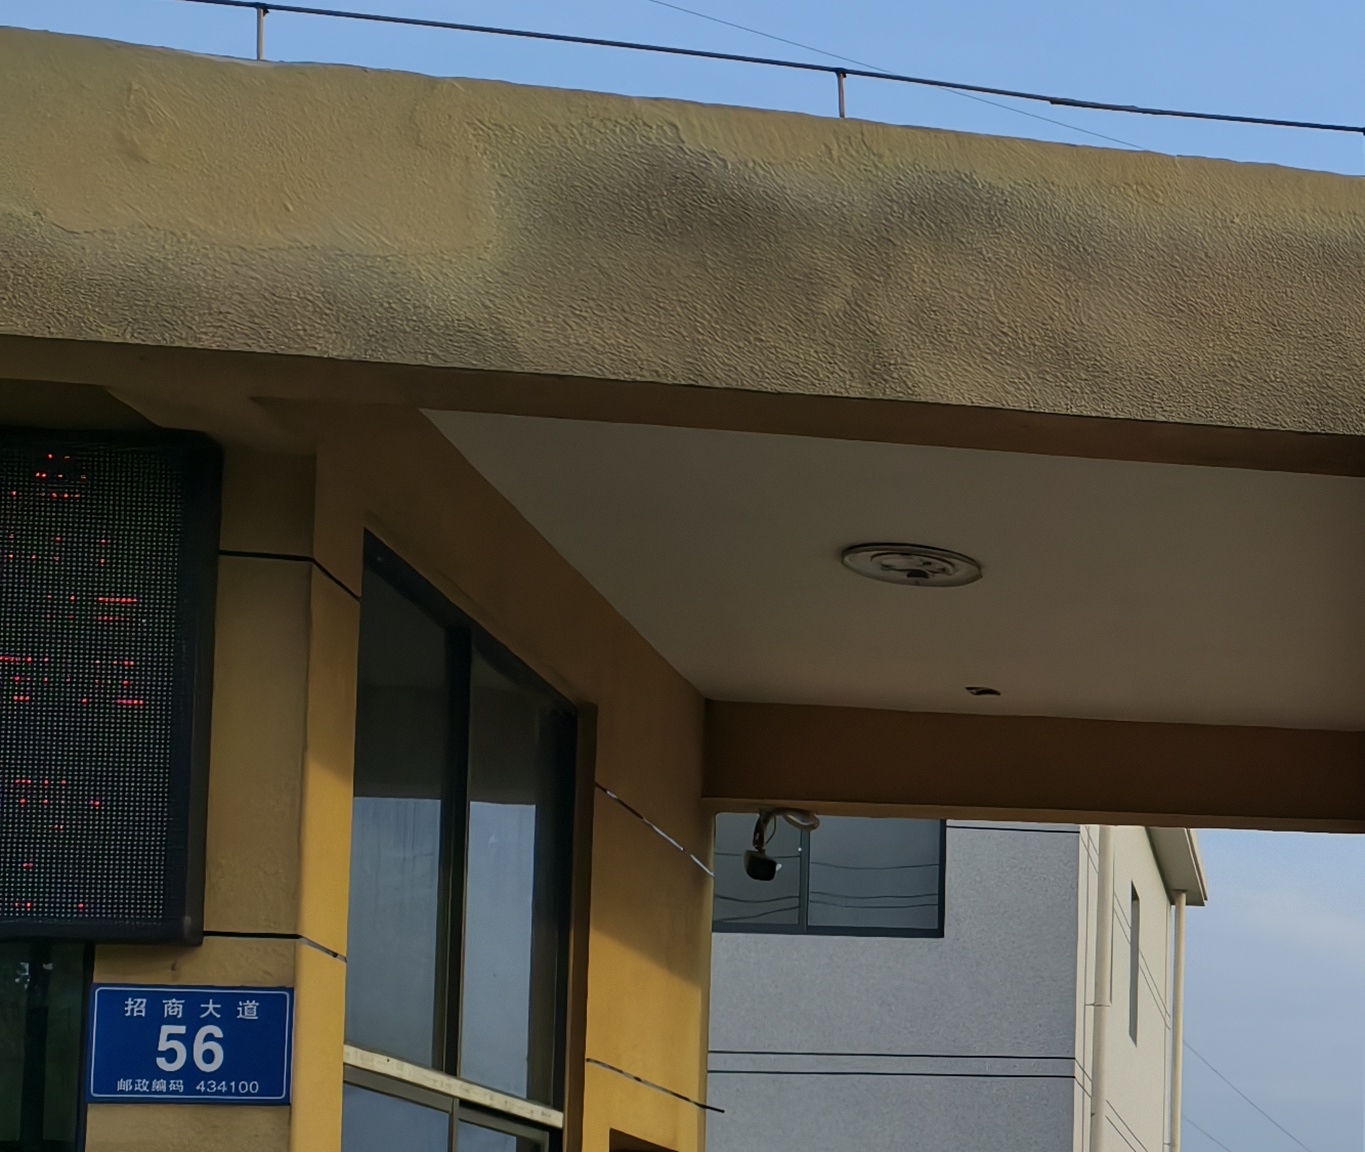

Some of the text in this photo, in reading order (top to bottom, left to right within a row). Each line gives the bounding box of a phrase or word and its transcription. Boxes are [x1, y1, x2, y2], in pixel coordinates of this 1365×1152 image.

[124, 997, 260, 1020] 招商大道
[156, 1024, 224, 1072] 56
[117, 1078, 259, 1094] 邮政编码 434100
